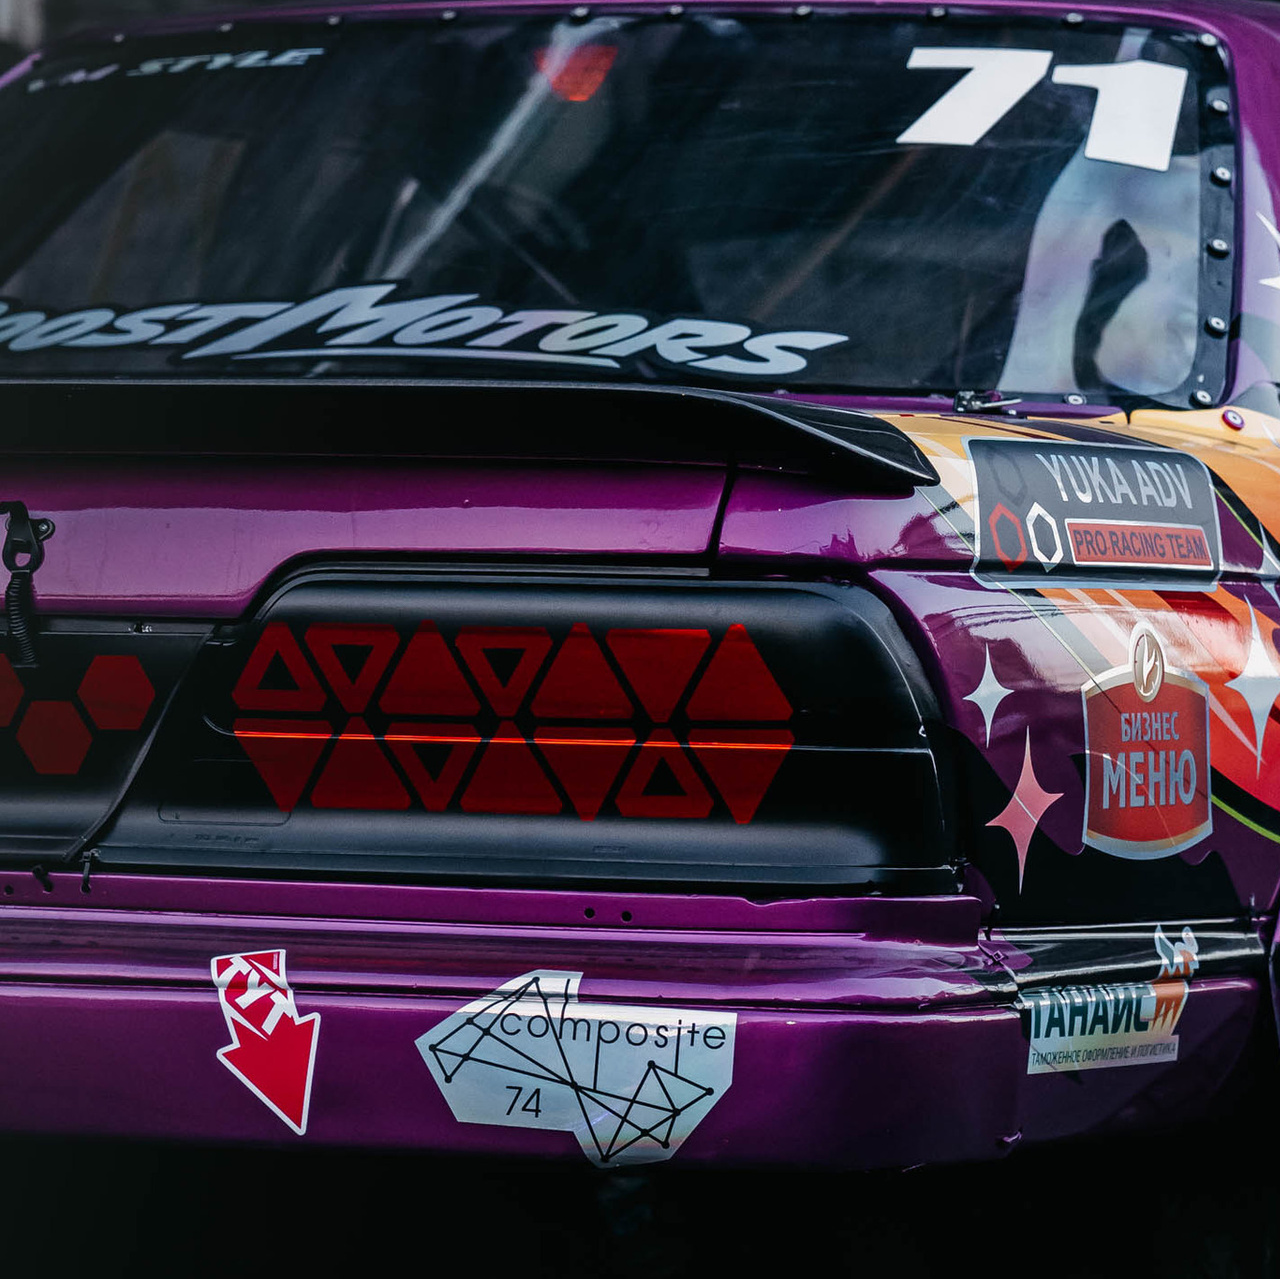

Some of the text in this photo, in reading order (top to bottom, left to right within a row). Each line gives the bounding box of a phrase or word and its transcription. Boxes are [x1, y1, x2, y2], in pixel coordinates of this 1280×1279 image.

[896, 47, 1188, 172] 71
[1035, 453, 1193, 509] YUKA ADV
[1074, 529, 1208, 560] PRO RACING TEAM
[1121, 711, 1180, 742] БИЗНЕС
[1102, 749, 1197, 810] МЕНЮ
[1022, 985, 1150, 1039] ТАНАИС
[500, 1011, 727, 1075] composite
[1032, 1049, 1081, 1066] ТАМОЖЕННОЕ
[1082, 1045, 1130, 1062] ОФОРМЛЕНИЕ
[505, 1085, 542, 1118] 74
